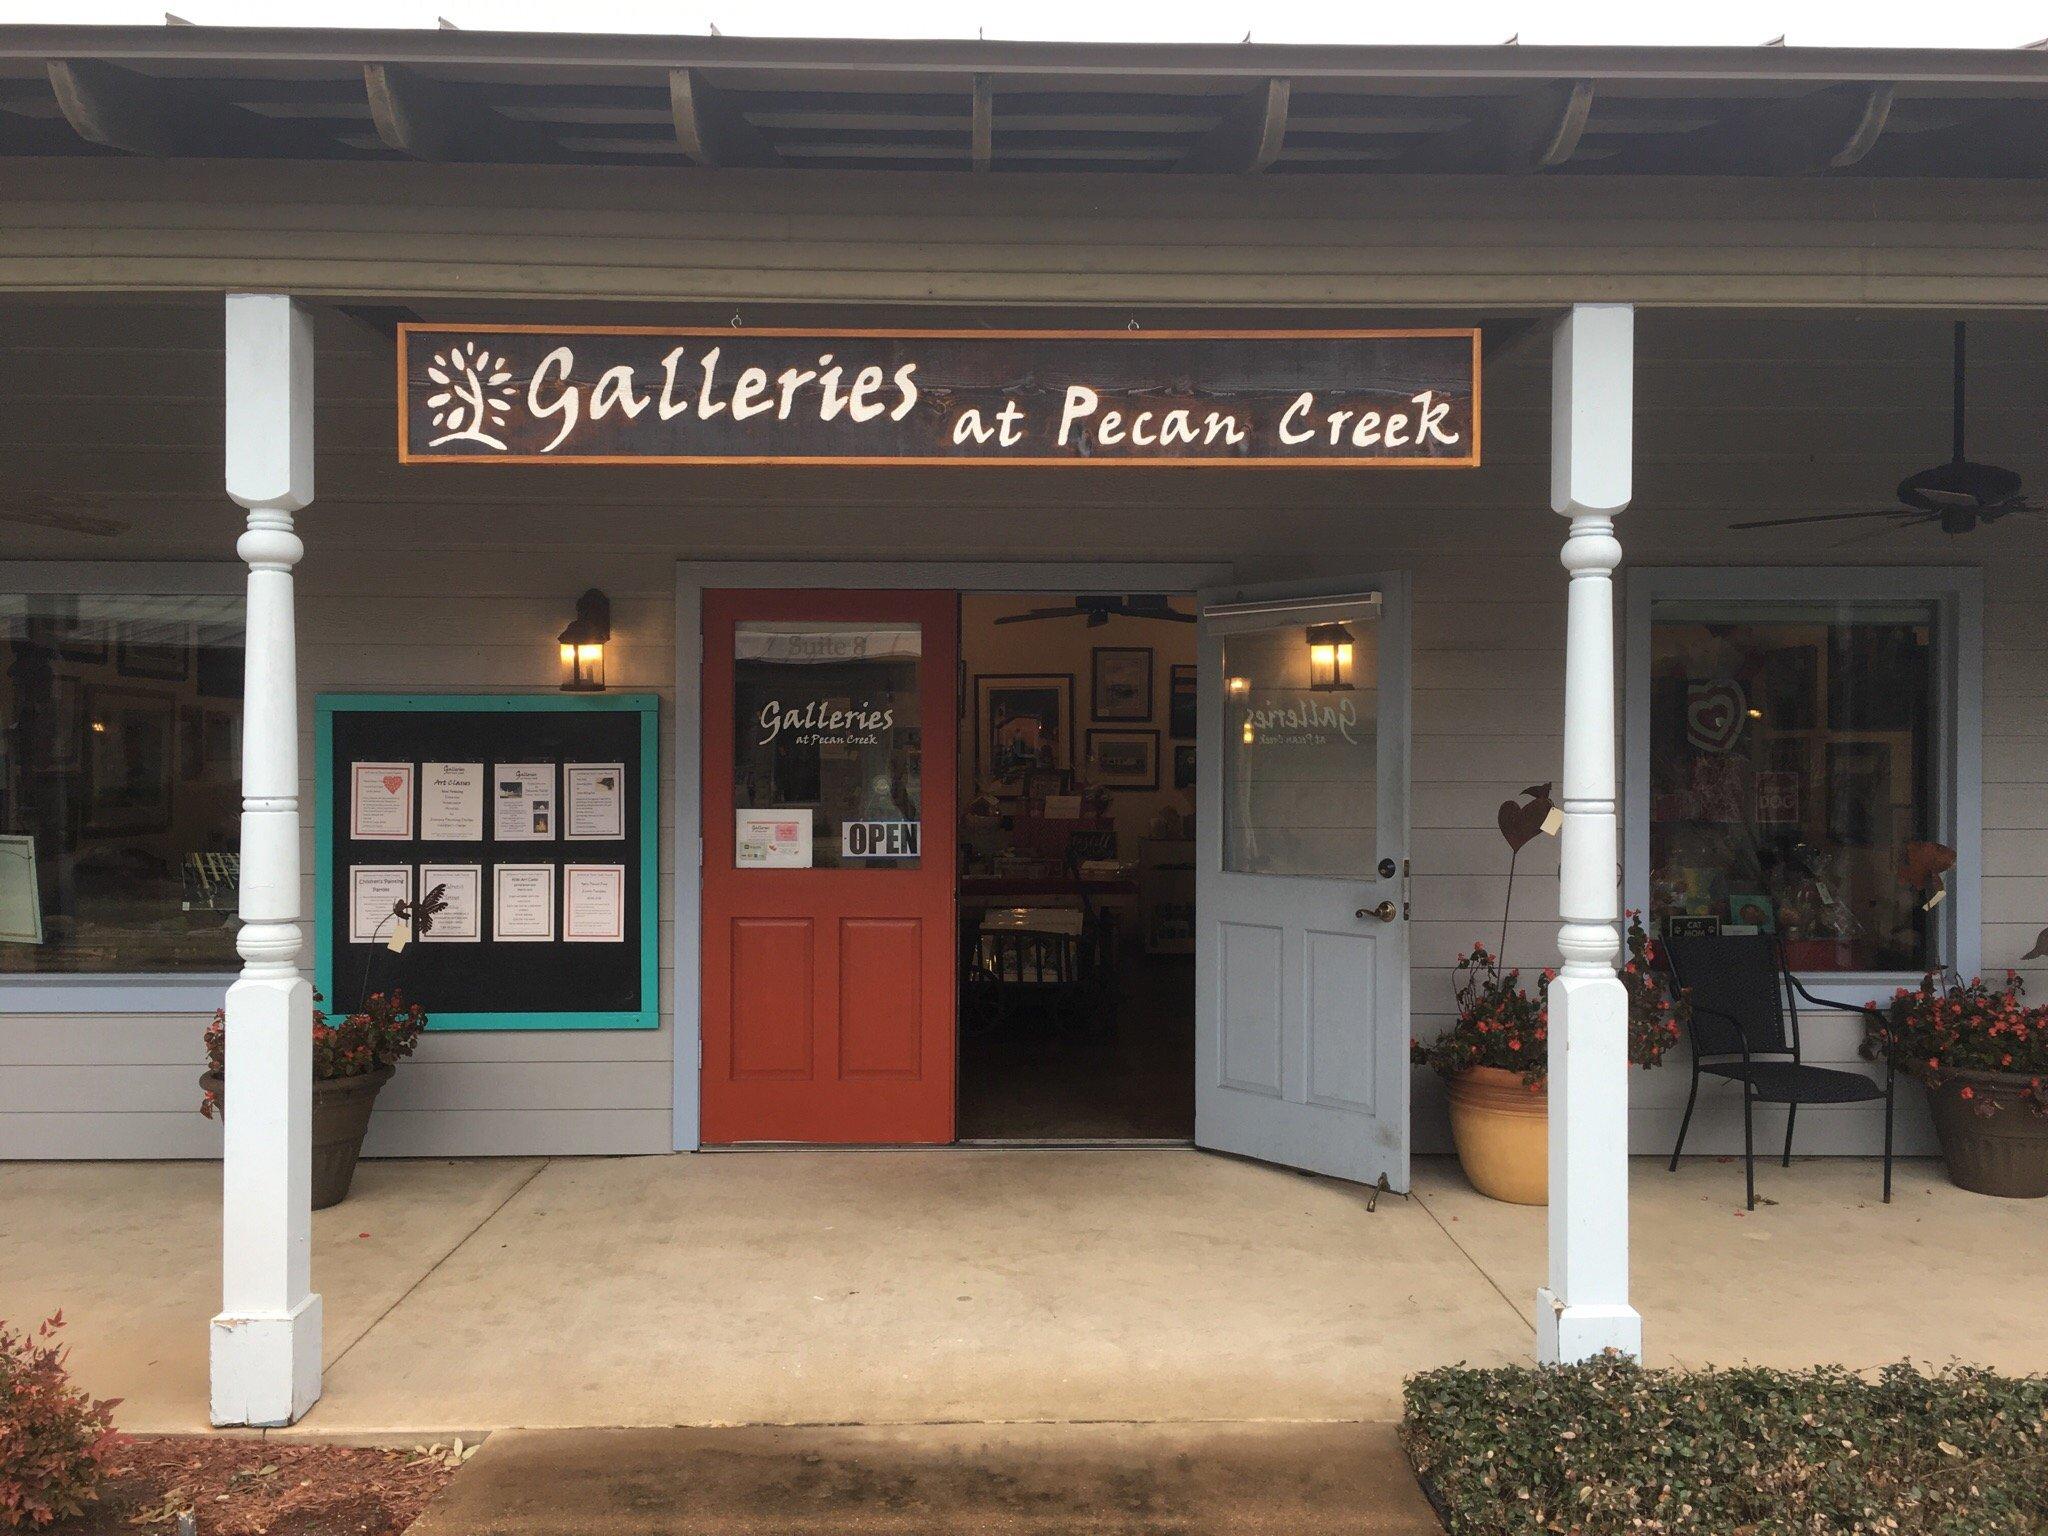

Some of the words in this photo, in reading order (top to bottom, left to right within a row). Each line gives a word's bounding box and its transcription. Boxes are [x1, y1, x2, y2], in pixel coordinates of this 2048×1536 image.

[526, 345, 919, 453] Galleries
[952, 400, 1024, 448] at
[1057, 385, 1245, 448] Pecan
[1278, 390, 1460, 448] Creek
[758, 700, 894, 746] Galleries
[795, 735, 809, 745] at
[811, 734, 845, 746] Pecan
[847, 734, 878, 745] Creek
[849, 823, 918, 855] OPEN
[1687, 921, 1702, 929] CAT
